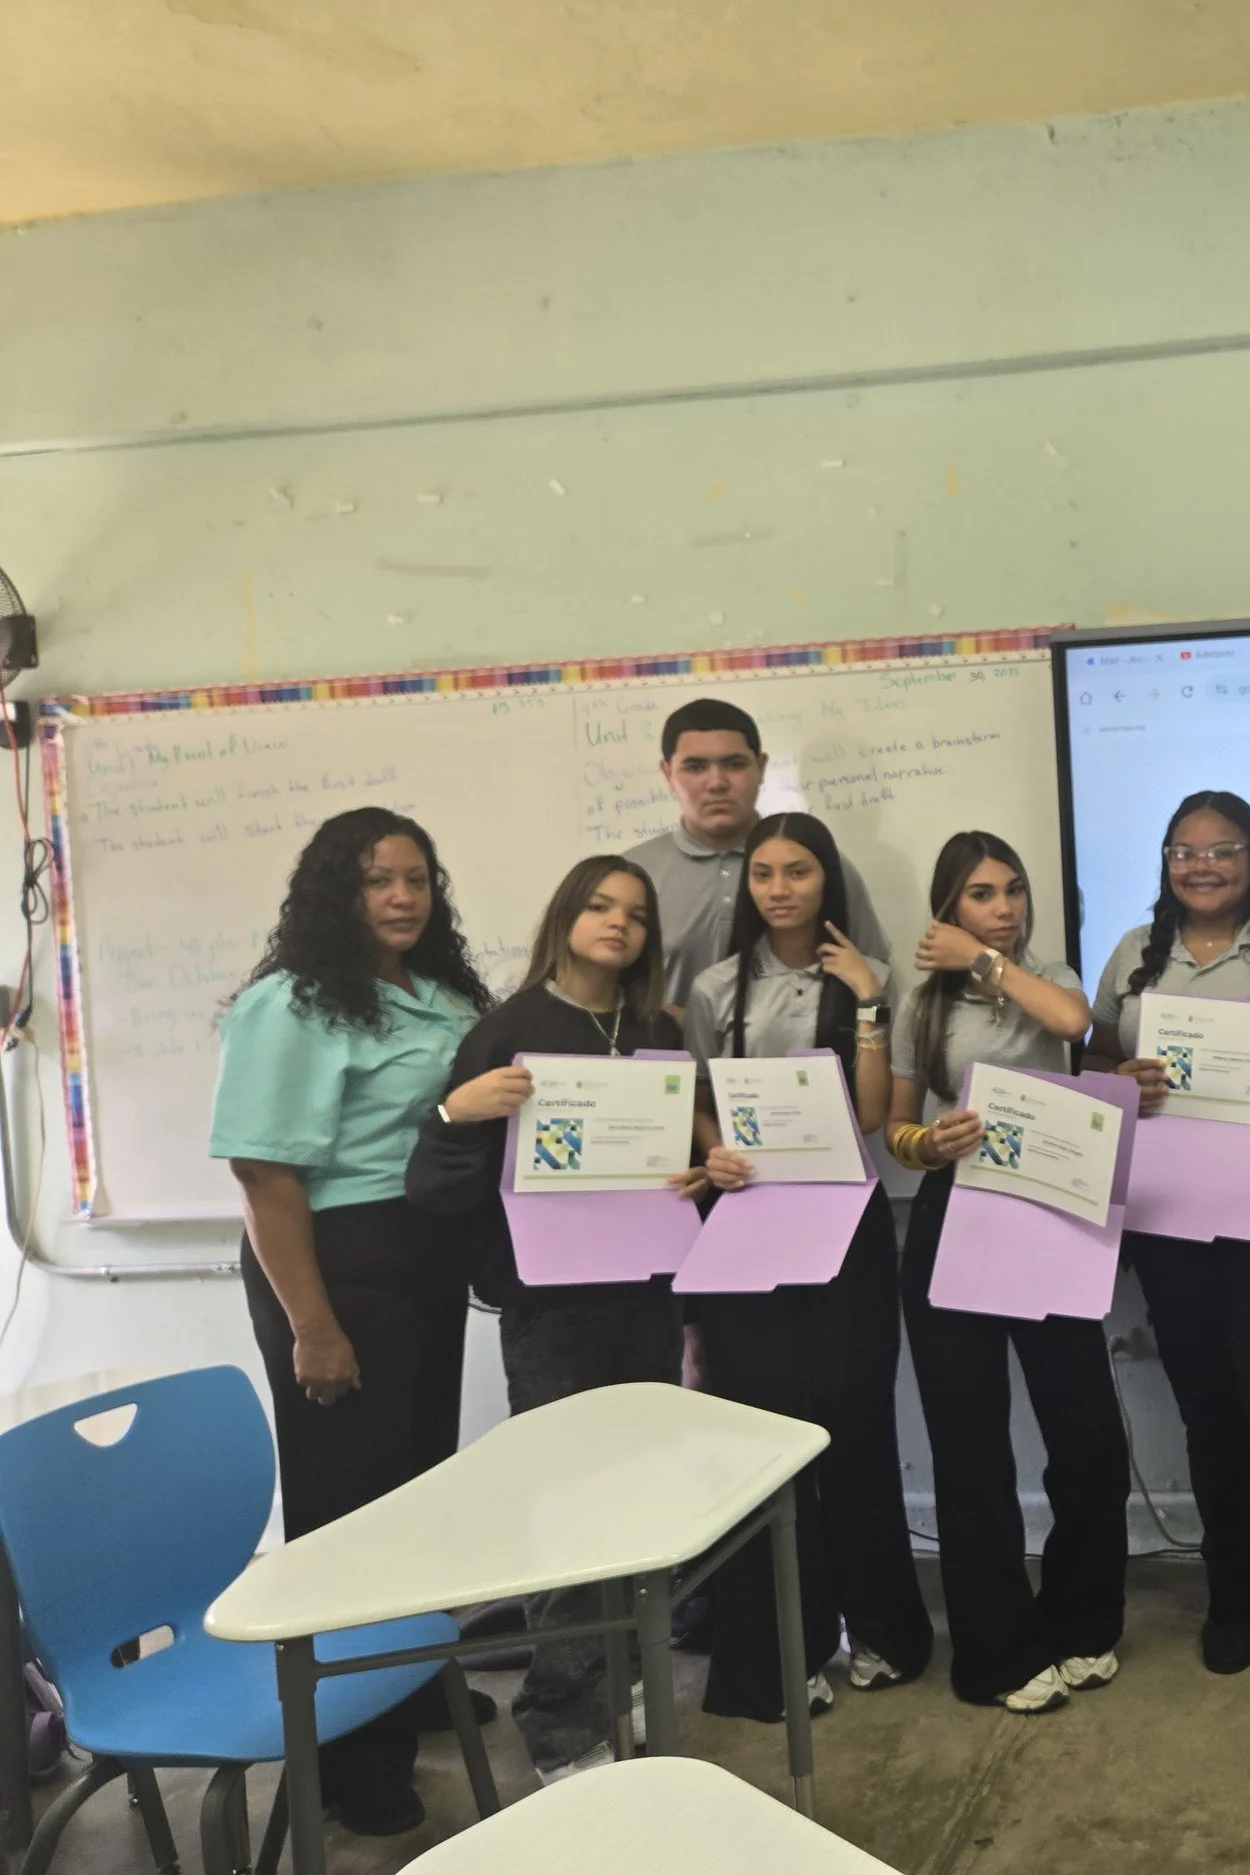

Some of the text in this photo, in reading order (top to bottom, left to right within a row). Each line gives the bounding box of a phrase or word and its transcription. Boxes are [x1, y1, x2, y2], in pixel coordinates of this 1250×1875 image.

[1158, 1028, 1204, 1039] Certificado
[538, 1099, 596, 1108] Certificado
[988, 1102, 1036, 1120] Certificado
